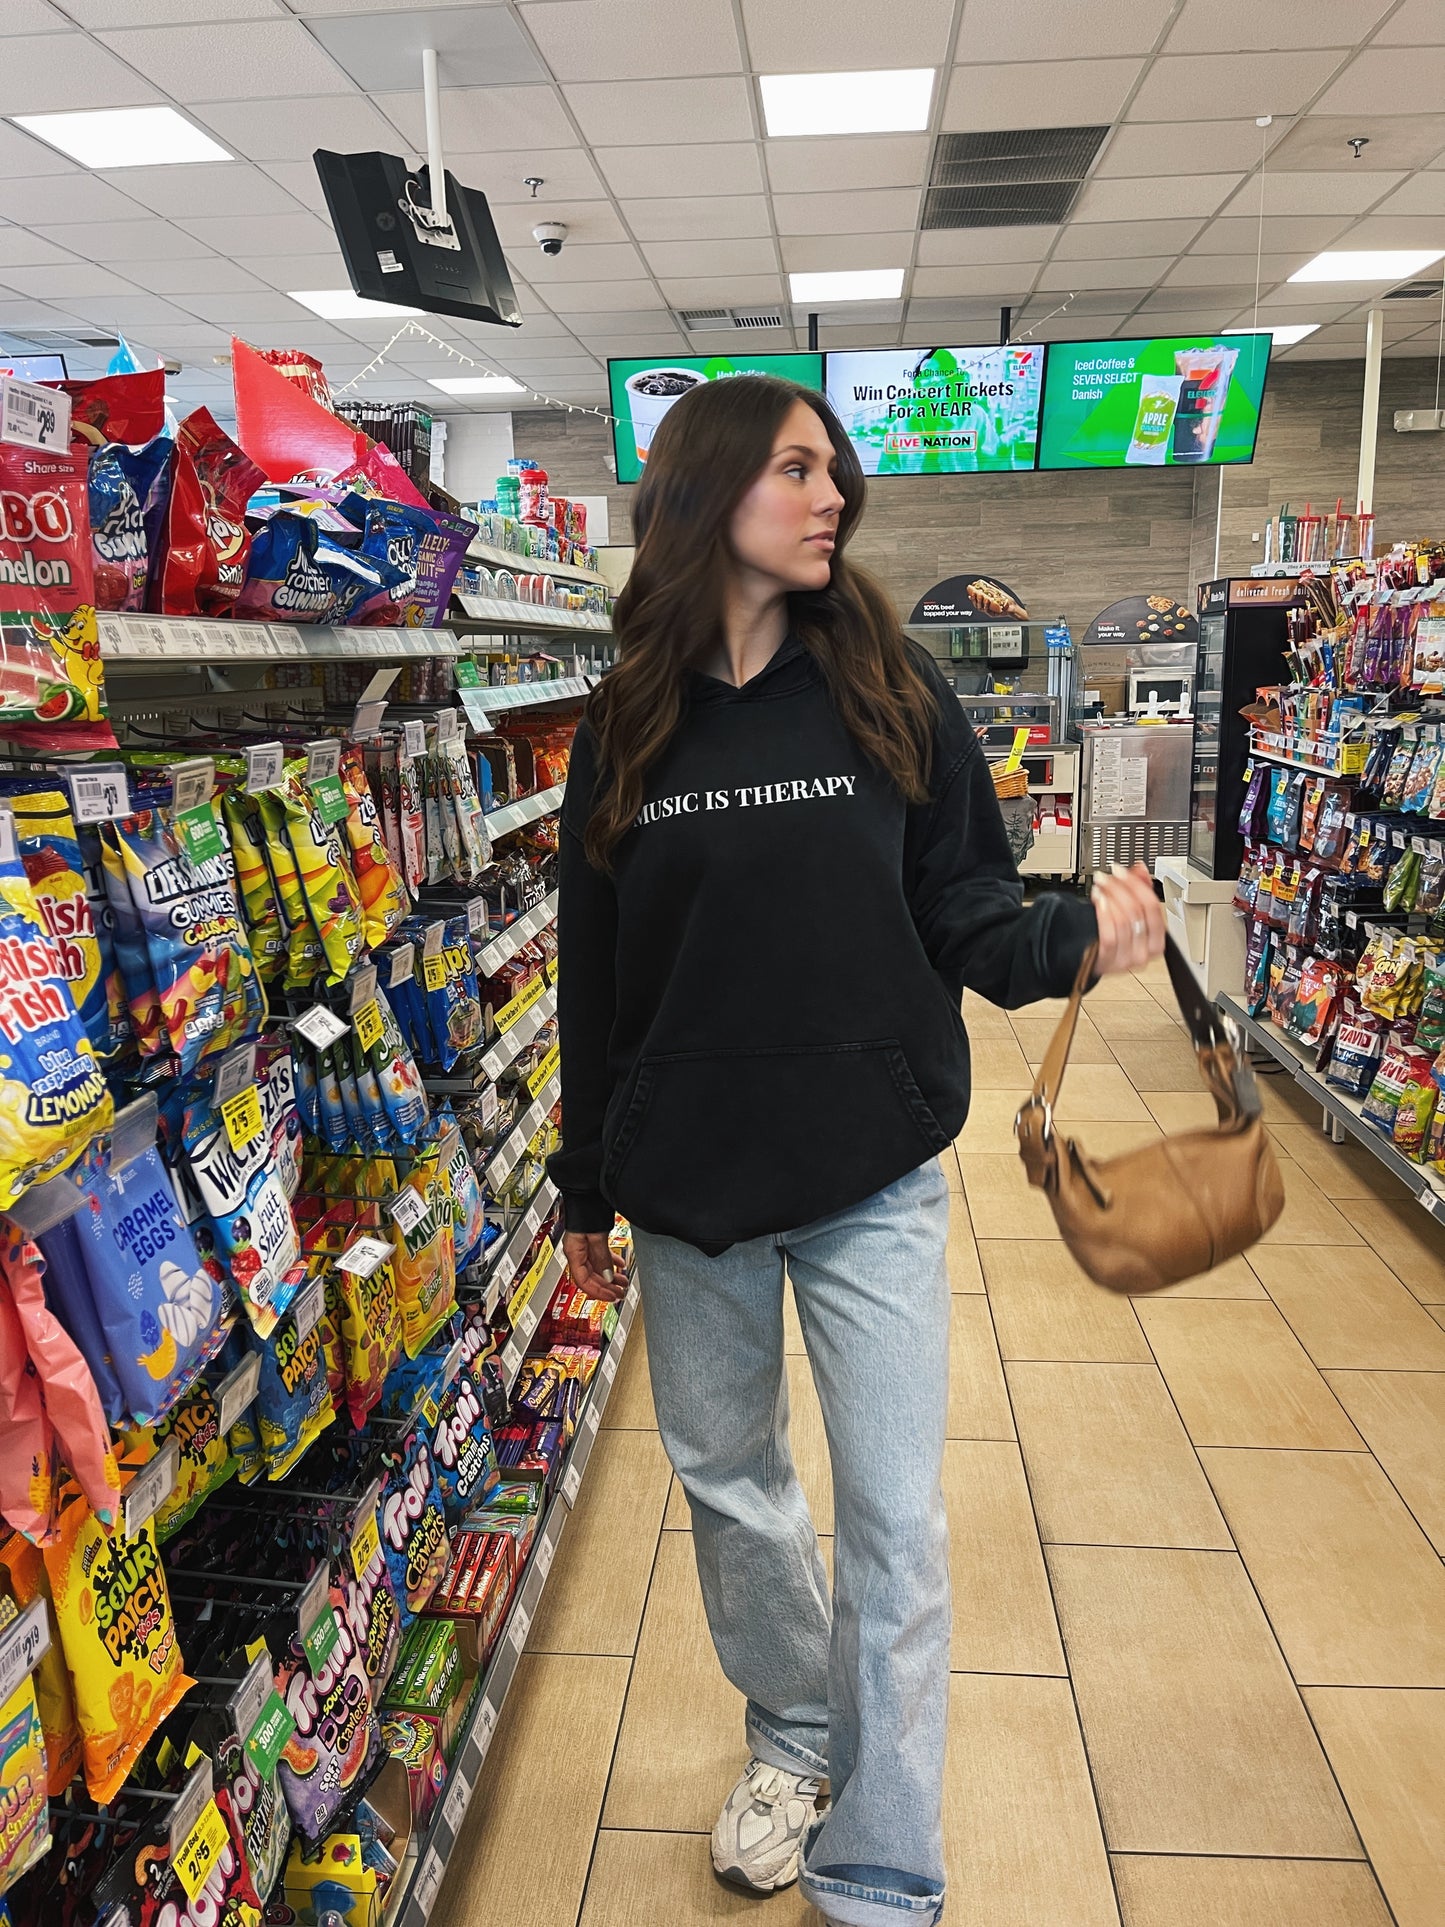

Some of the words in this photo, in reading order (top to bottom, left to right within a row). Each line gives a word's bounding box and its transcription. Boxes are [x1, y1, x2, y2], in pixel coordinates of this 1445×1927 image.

[924, 368, 954, 377] Chance
[1072, 374, 1103, 386] SEVEN
[1104, 373, 1138, 384] SELECT
[1074, 359, 1095, 371] Iced
[1095, 358, 1126, 370] Coffee
[1127, 358, 1135, 369] &
[854, 386, 883, 401] Win
[887, 383, 951, 399] Concert
[955, 382, 1014, 397] Tickets
[1071, 389, 1103, 400] Danish
[888, 404, 917, 418] For
[919, 407, 926, 418] a
[930, 402, 972, 416] YEAR
[1142, 412, 1169, 426] APPLE
[892, 438, 919, 448] LIVE
[923, 437, 971, 447] NATION
[25, 461, 57, 474] Share
[58, 464, 75, 473] size
[1236, 586, 1269, 597] delivered
[1271, 585, 1290, 597] fresh
[923, 610, 945, 618] topped
[1112, 631, 1126, 639] way
[705, 789, 730, 811] IS
[734, 775, 857, 808] THERAPY
[170, 892, 236, 928] GUMMIES
[1339, 1026, 1372, 1048] DAVID
[31, 1054, 95, 1096] raspberry
[39, 1048, 72, 1071] blue
[112, 1188, 174, 1252] CARAMEL
[130, 1219, 176, 1267] EGGS
[281, 1326, 321, 1393] PATCH
[433, 1379, 481, 1467] Trolli
[456, 1435, 478, 1477] Gummi
[456, 1434, 490, 1497] Creations
[383, 1444, 431, 1550] Trolli
[406, 1515, 445, 1591] Crawlers
[407, 1529, 425, 1562] SOUR
[96, 1543, 156, 1629] SOUR
[103, 1564, 164, 1661] PATCH
[414, 1664, 429, 1687] Mike
[323, 1684, 344, 1717] SOUR
[258, 1723, 274, 1750] 300
[336, 1697, 368, 1754] Crawlers
[318, 1755, 340, 1793] SOFT
[177, 1847, 190, 1868] Trolli
[187, 1830, 199, 1849] Bag
